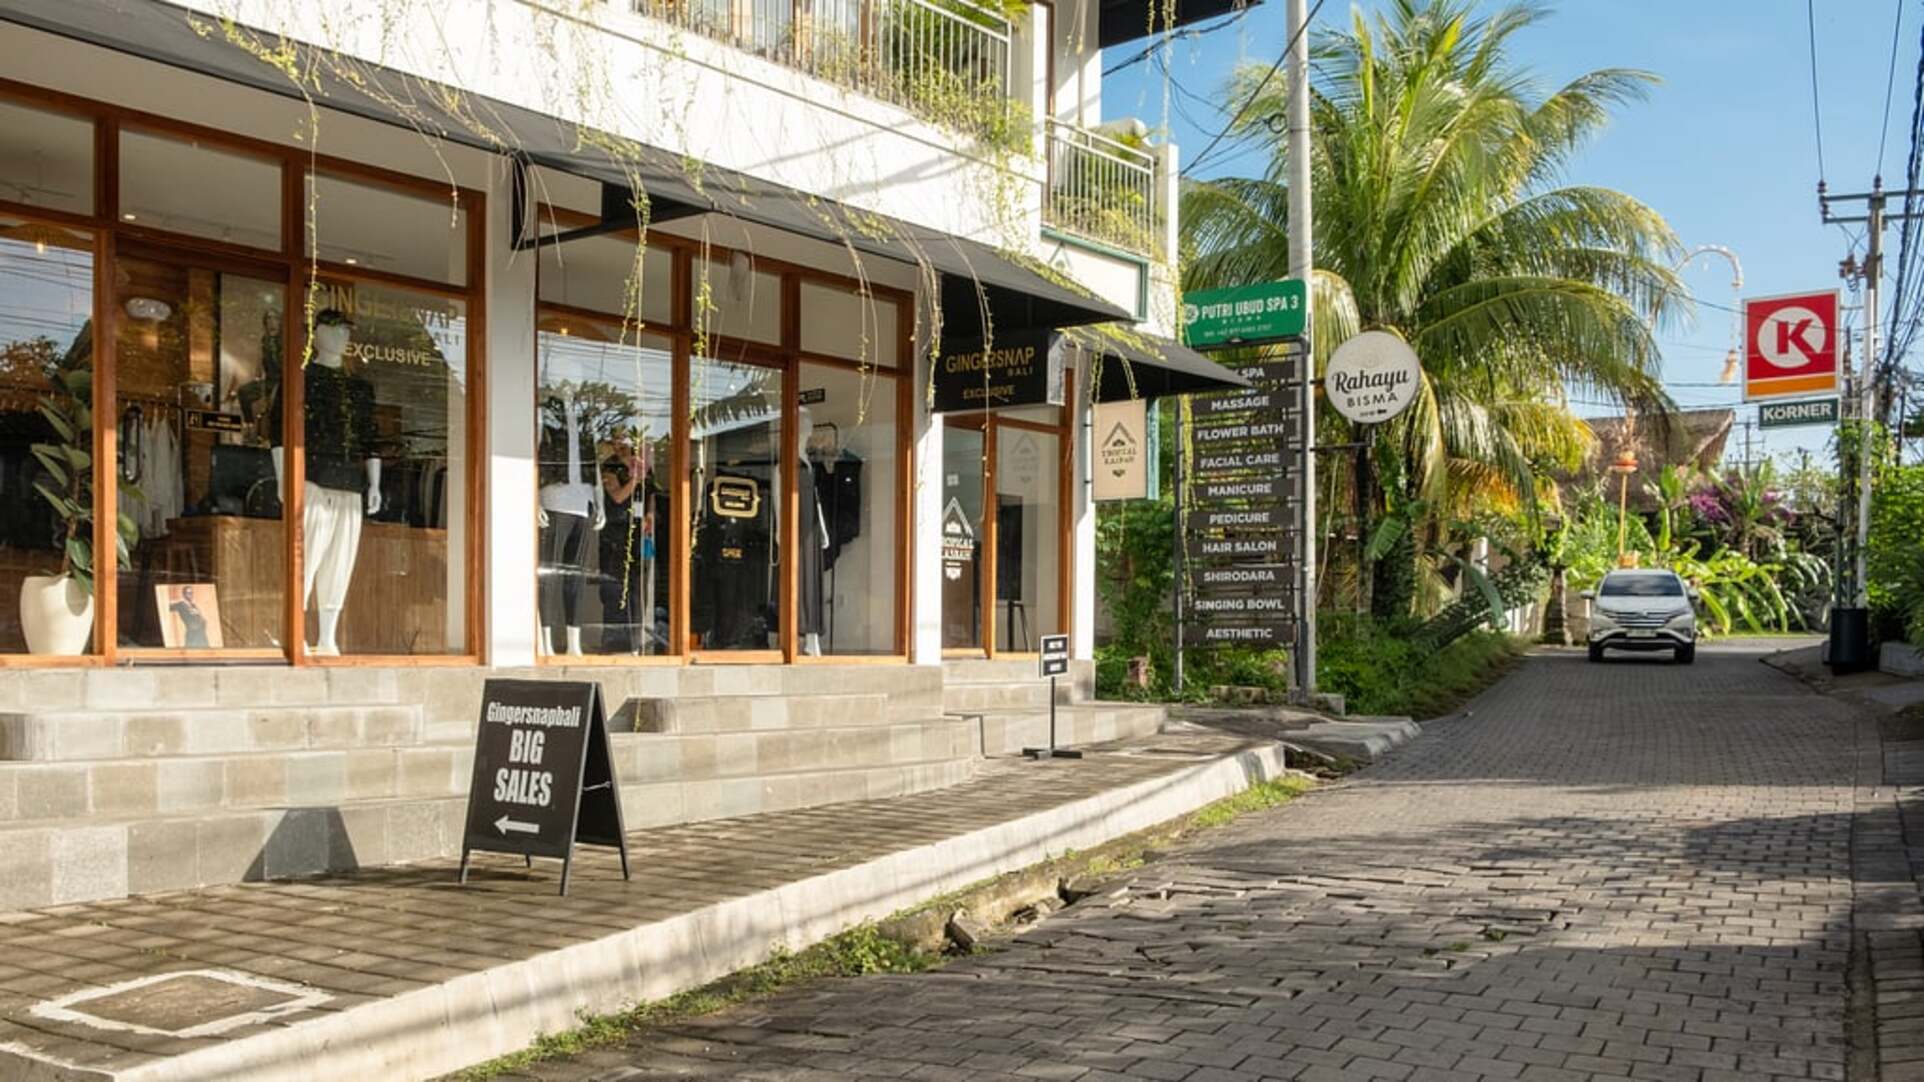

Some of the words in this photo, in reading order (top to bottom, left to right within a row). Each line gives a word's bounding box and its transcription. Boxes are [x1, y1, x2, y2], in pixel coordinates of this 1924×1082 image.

[1202, 303, 1233, 319] PUTRI
[1235, 299, 1264, 316] UBUD
[1266, 296, 1288, 312] SPA
[1290, 294, 1299, 309] 3
[1776, 318, 1818, 358] K
[344, 342, 431, 367] EXCLUSIVE
[946, 347, 1035, 373] GINGERSNAP
[1241, 367, 1265, 378] SPA
[1332, 370, 1410, 394] Rahayu
[1211, 396, 1269, 411] MASSAGE
[1347, 392, 1398, 408] BISMA
[1197, 426, 1248, 440] FLOWER
[1250, 424, 1284, 436] BATH
[1200, 456, 1242, 469] FACIAL
[1245, 453, 1280, 466] CARE
[1207, 482, 1272, 496] MANICURE
[1209, 512, 1269, 525] PEDICURE
[1202, 542, 1232, 553] HAIR
[1234, 541, 1277, 552] SALON
[1203, 571, 1275, 582] SHIRODARA
[1195, 600, 1244, 610] SINGING
[1247, 599, 1284, 609] BOWL
[1205, 628, 1273, 639] AESTHETIC
[486, 701, 582, 728] Gingersnapbali
[508, 728, 546, 765] BIG
[493, 767, 553, 807] SALES
